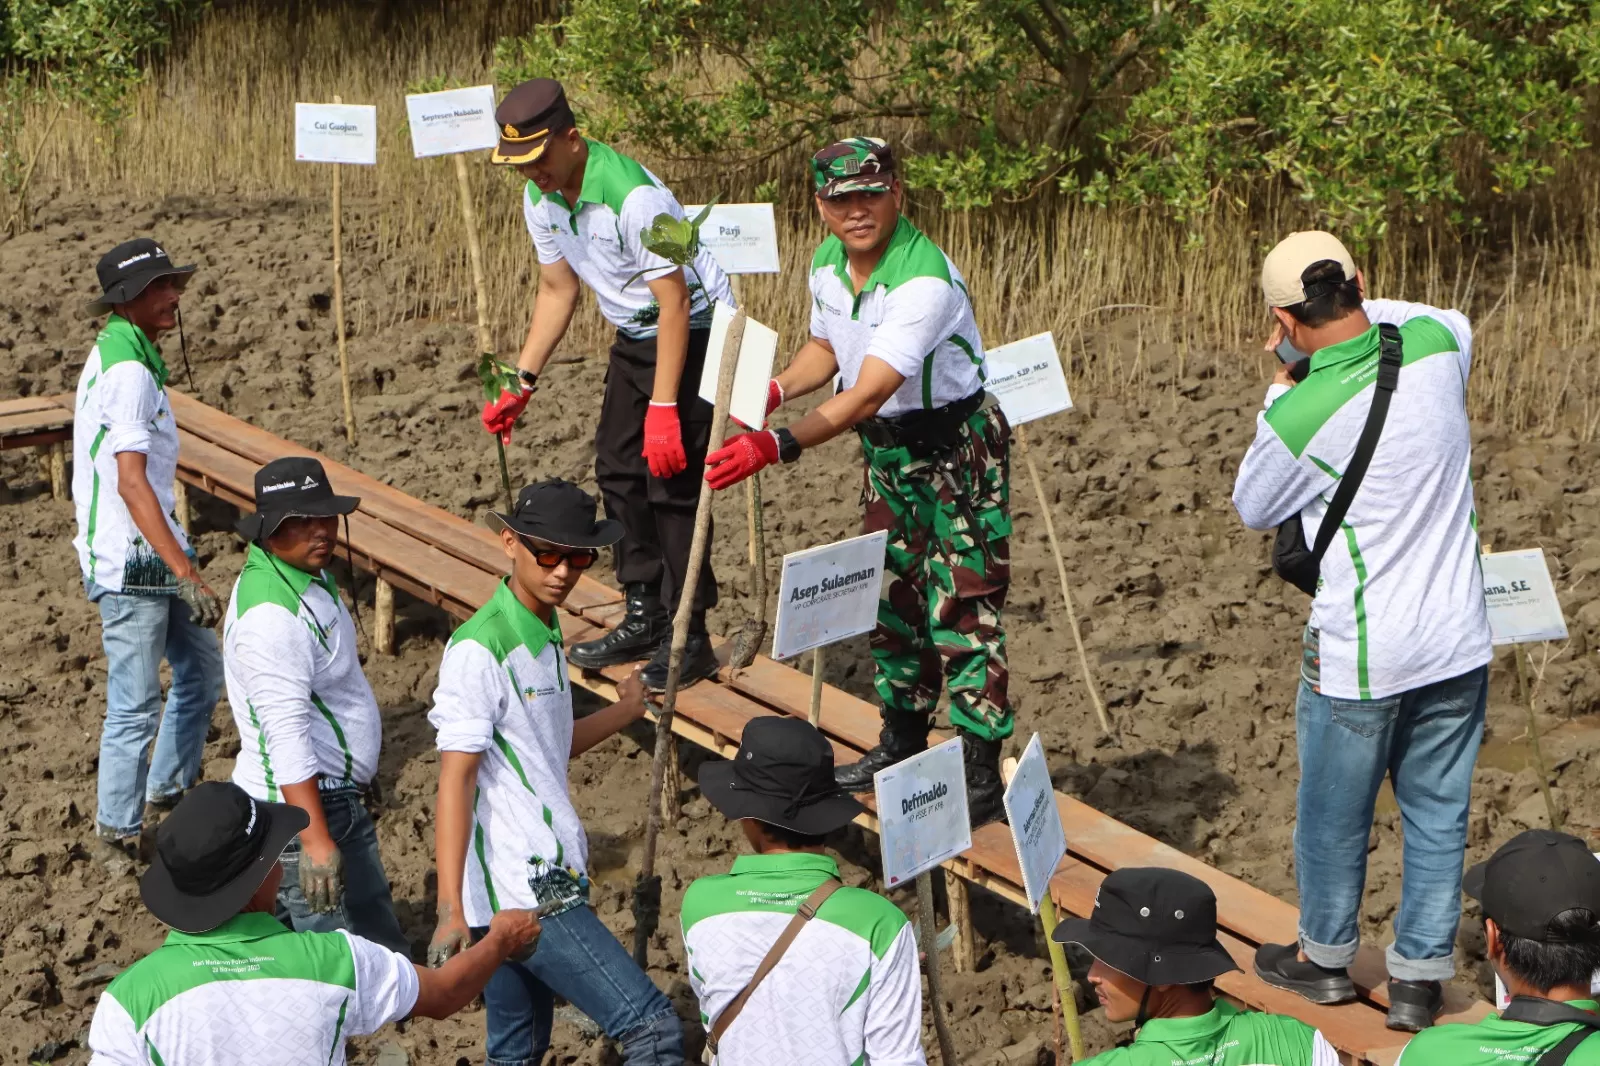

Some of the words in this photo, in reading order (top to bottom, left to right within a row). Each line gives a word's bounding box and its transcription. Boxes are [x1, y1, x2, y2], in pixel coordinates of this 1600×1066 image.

[314, 121, 327, 130] Cui
[329, 122, 358, 133] Guojun
[789, 583, 819, 604] Asep
[820, 566, 876, 594] Sulaeman
[901, 781, 949, 816] Defrinaldo
